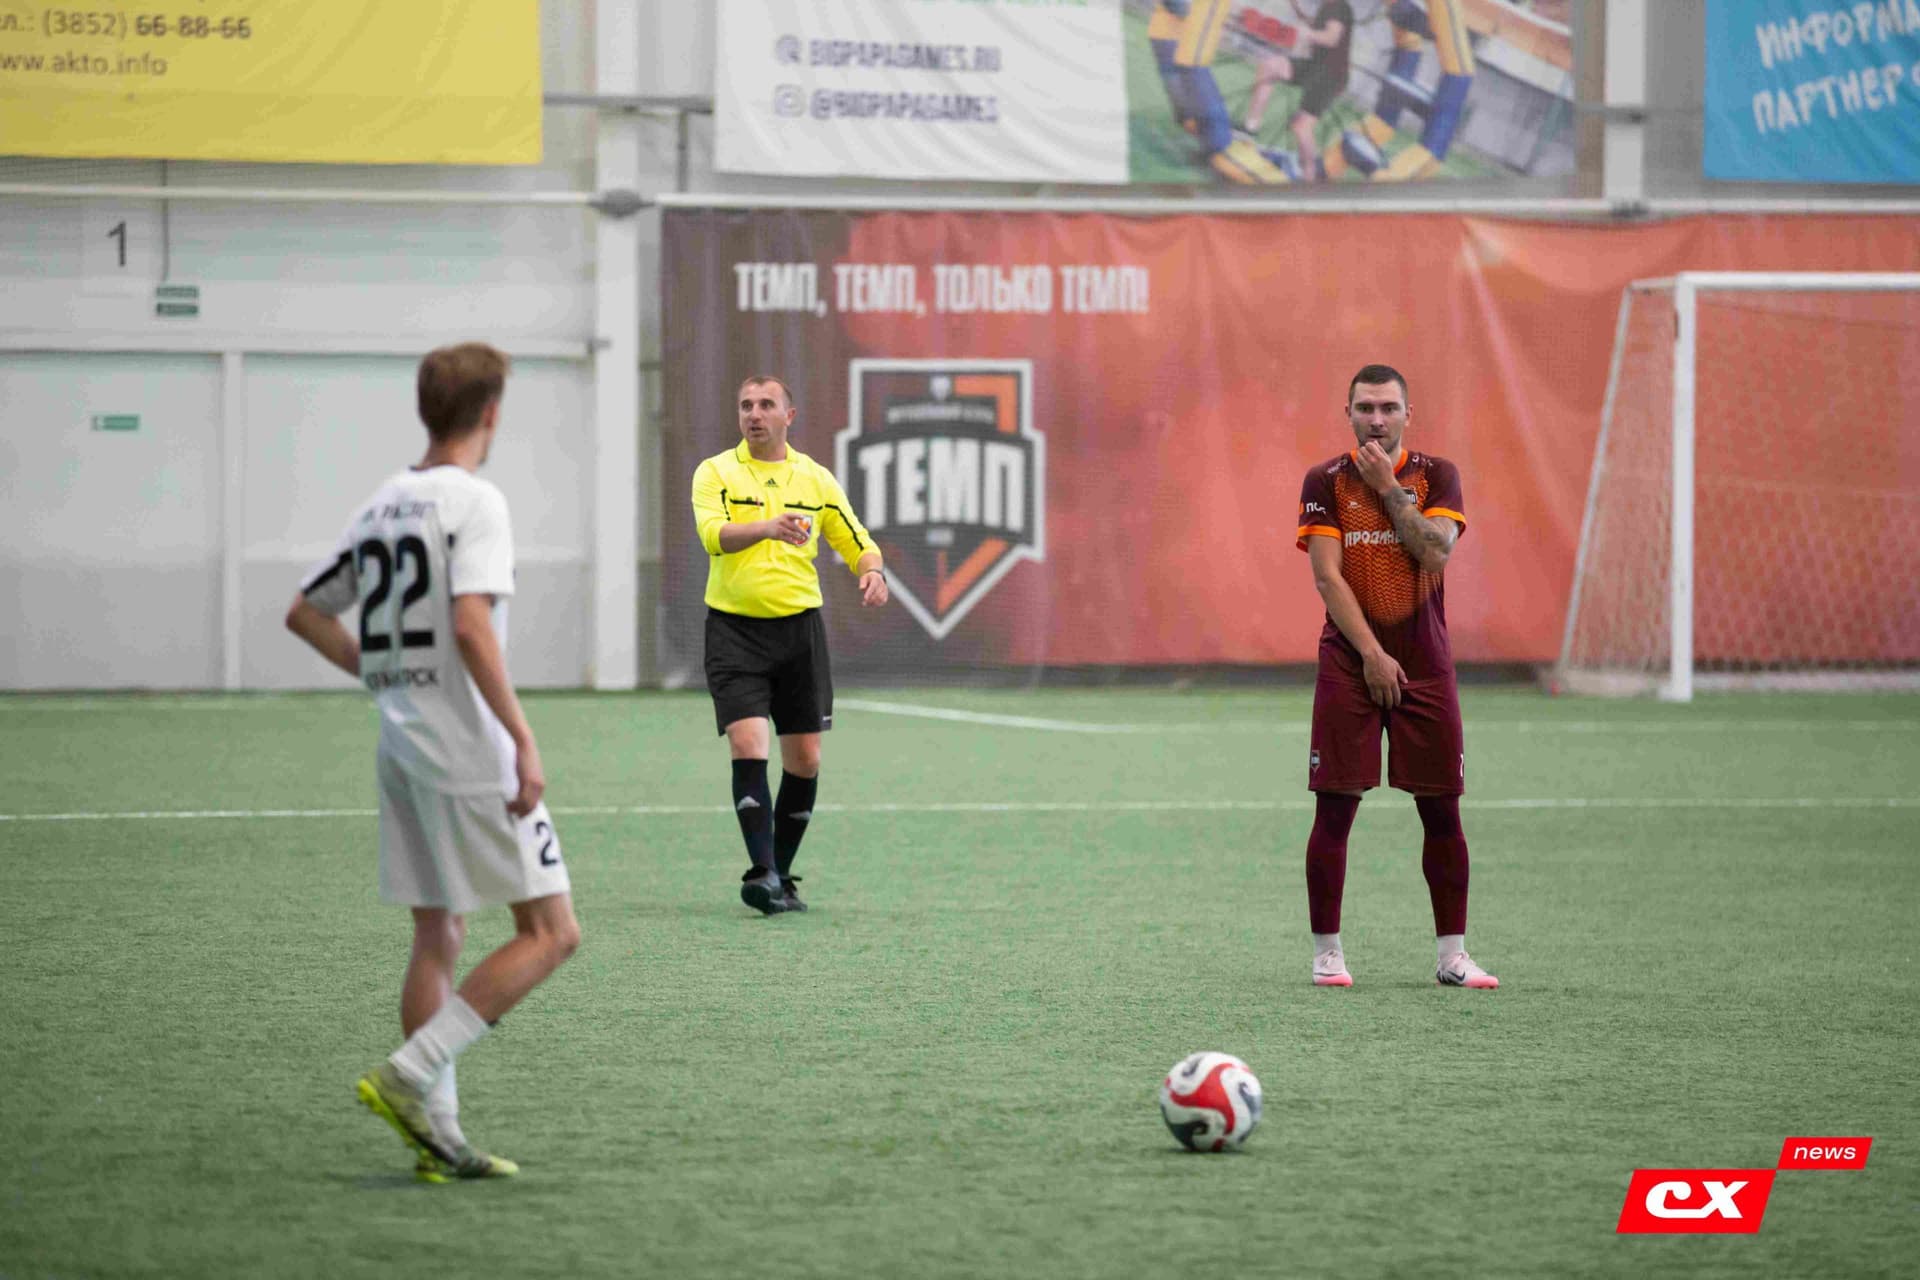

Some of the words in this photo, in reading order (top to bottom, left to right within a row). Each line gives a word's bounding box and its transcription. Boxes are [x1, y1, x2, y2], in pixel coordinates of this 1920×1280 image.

[0, 13, 35, 32] л.:
[43, 9, 127, 39] (3852)
[135, 14, 251, 39] 66-88-66
[1753, 63, 1903, 134] ПАРТНЕР
[107, 221, 126, 266] 1
[734, 262, 827, 317] ТЕМП,
[833, 264, 926, 317] ТЕМП,
[934, 265, 1053, 313] ТОЛЬКО
[1061, 266, 1150, 314] ТЕМП!
[858, 437, 1025, 532] ТЕМП
[358, 534, 436, 651] 22
